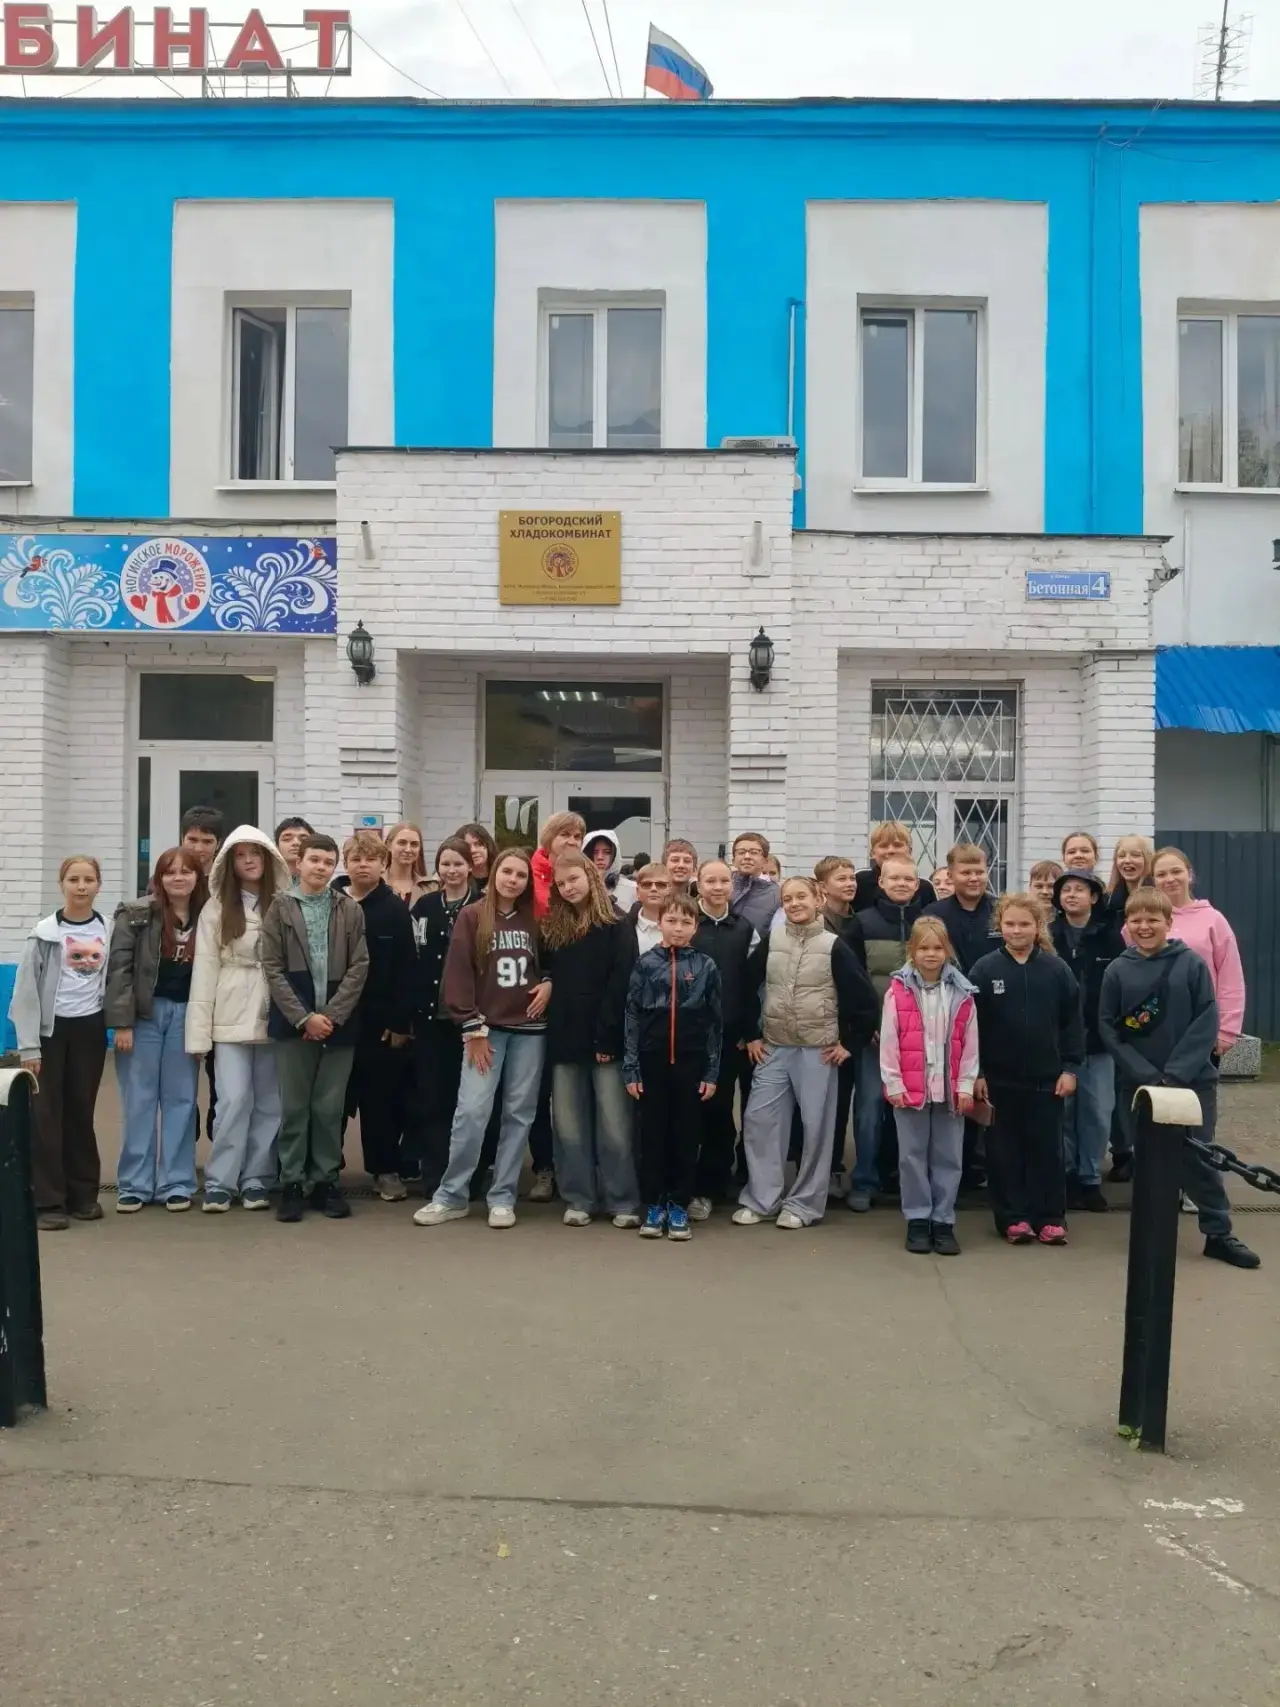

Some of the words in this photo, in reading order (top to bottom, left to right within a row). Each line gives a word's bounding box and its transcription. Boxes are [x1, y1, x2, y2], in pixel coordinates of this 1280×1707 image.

[3, 3, 351, 74] БИНАТ
[518, 514, 603, 527] БОГОРОДСКИЙ
[510, 529, 612, 540] ХЛАДОКОМБИНАТ
[125, 543, 162, 594] НОГИНСКОЕ
[164, 543, 207, 594] МОРОЖЕНОЕ
[1091, 576, 1107, 595] 4
[496, 956, 528, 988] 91
